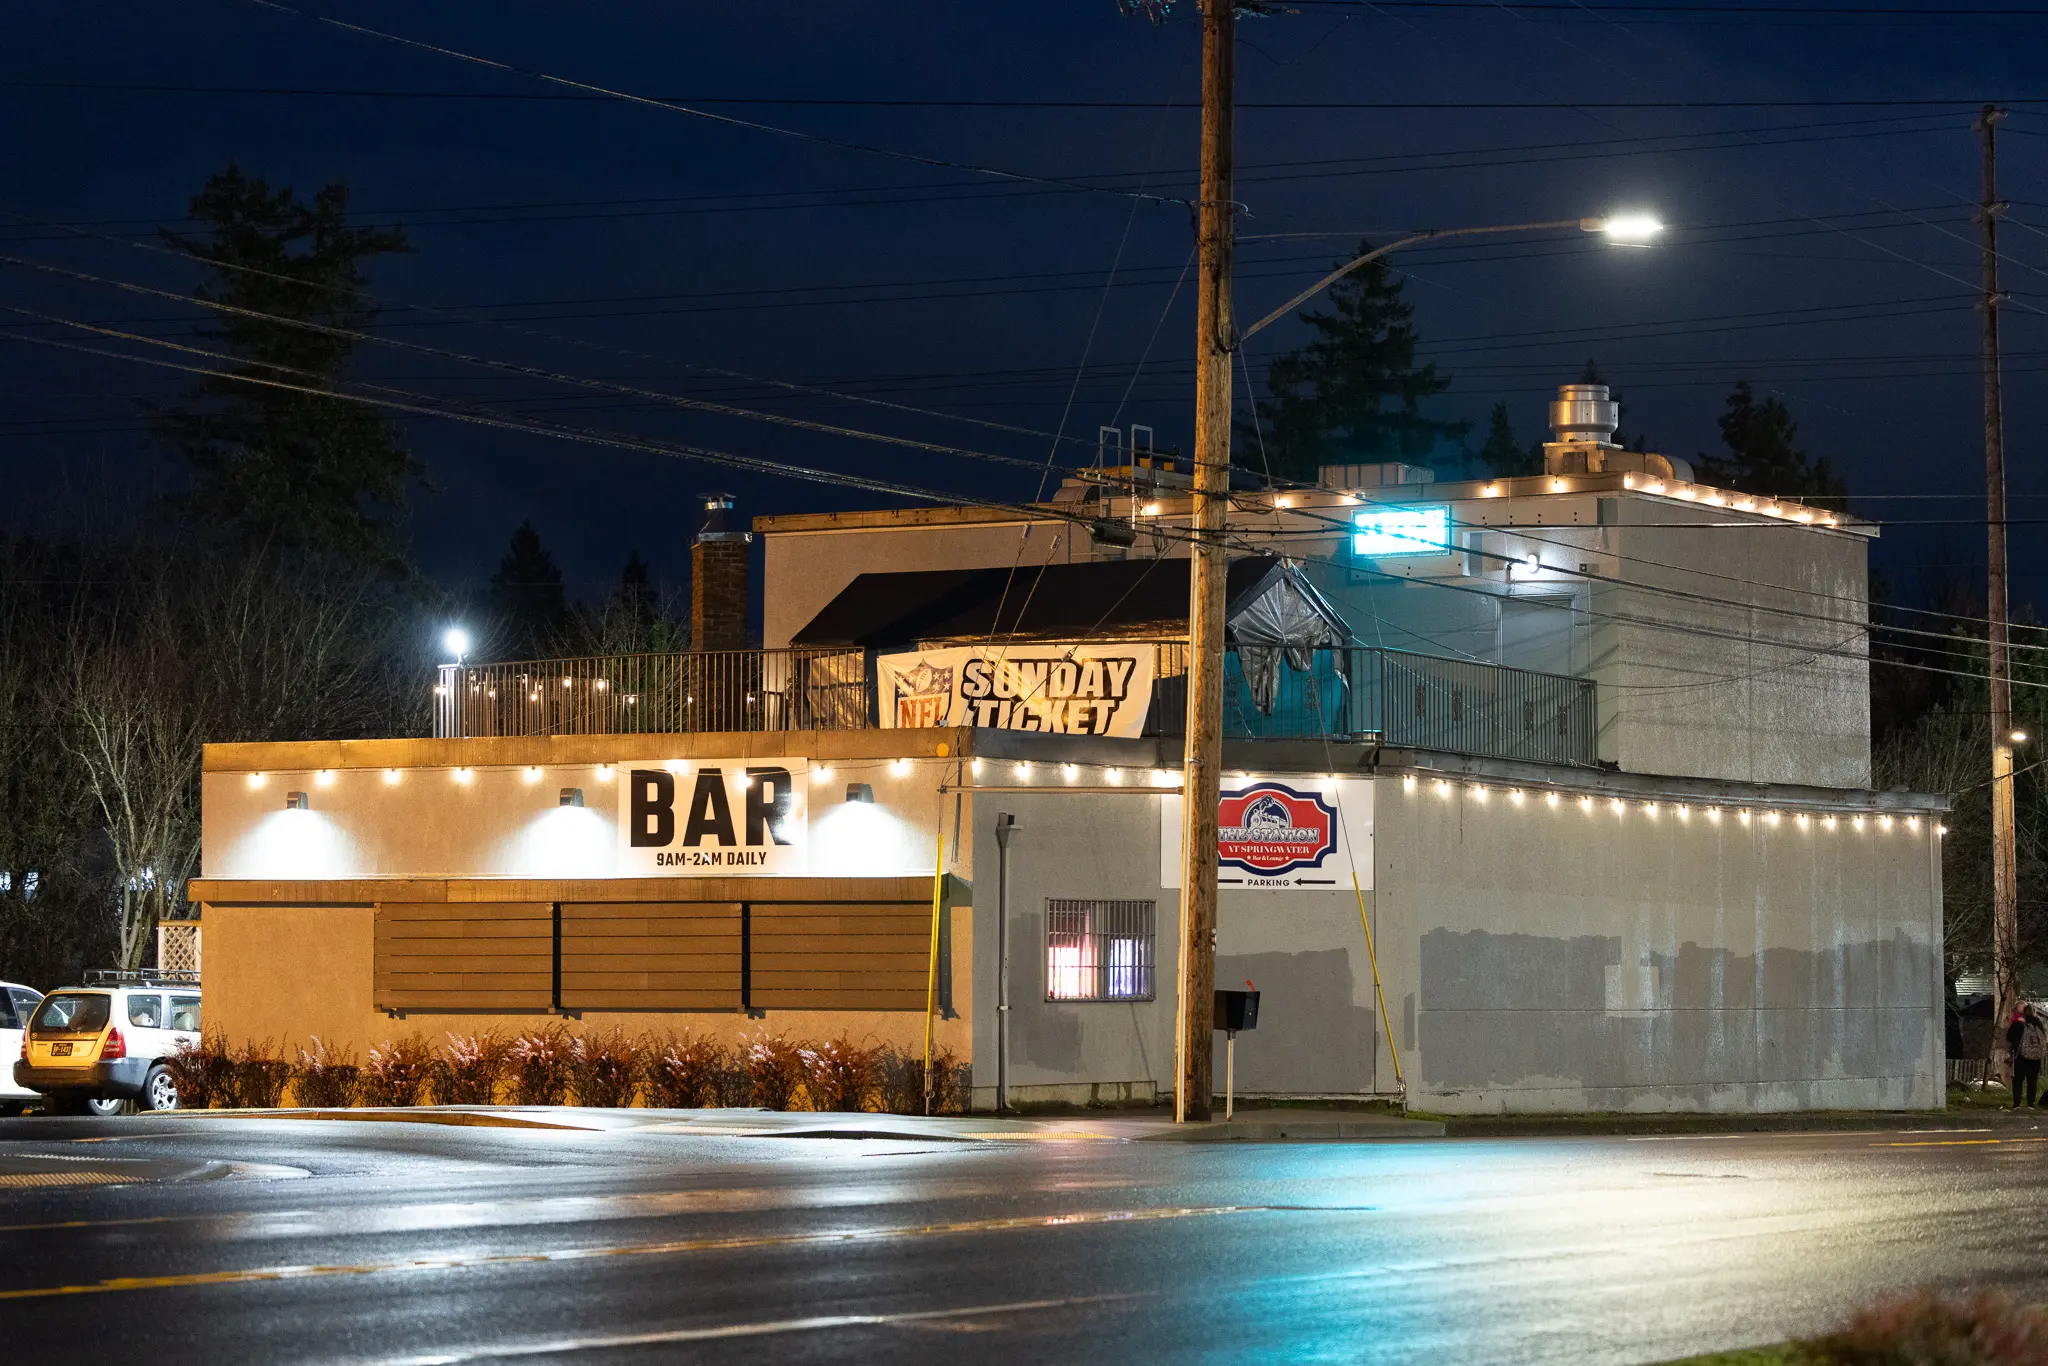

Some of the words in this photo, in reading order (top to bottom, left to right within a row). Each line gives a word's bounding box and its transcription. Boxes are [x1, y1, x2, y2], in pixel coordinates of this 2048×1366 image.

[961, 658, 1136, 700] SUNDAY
[900, 697, 943, 728] NFL
[971, 699, 1118, 736] TICKET
[631, 766, 792, 847] BAR
[1251, 828, 1319, 843] STATION
[656, 852, 722, 866] 9AM-2AM
[727, 852, 767, 865] DAILY
[1228, 845, 1240, 853] AT
[1241, 845, 1309, 853] SPRINGWATER
[1247, 878, 1290, 887] PARKING
